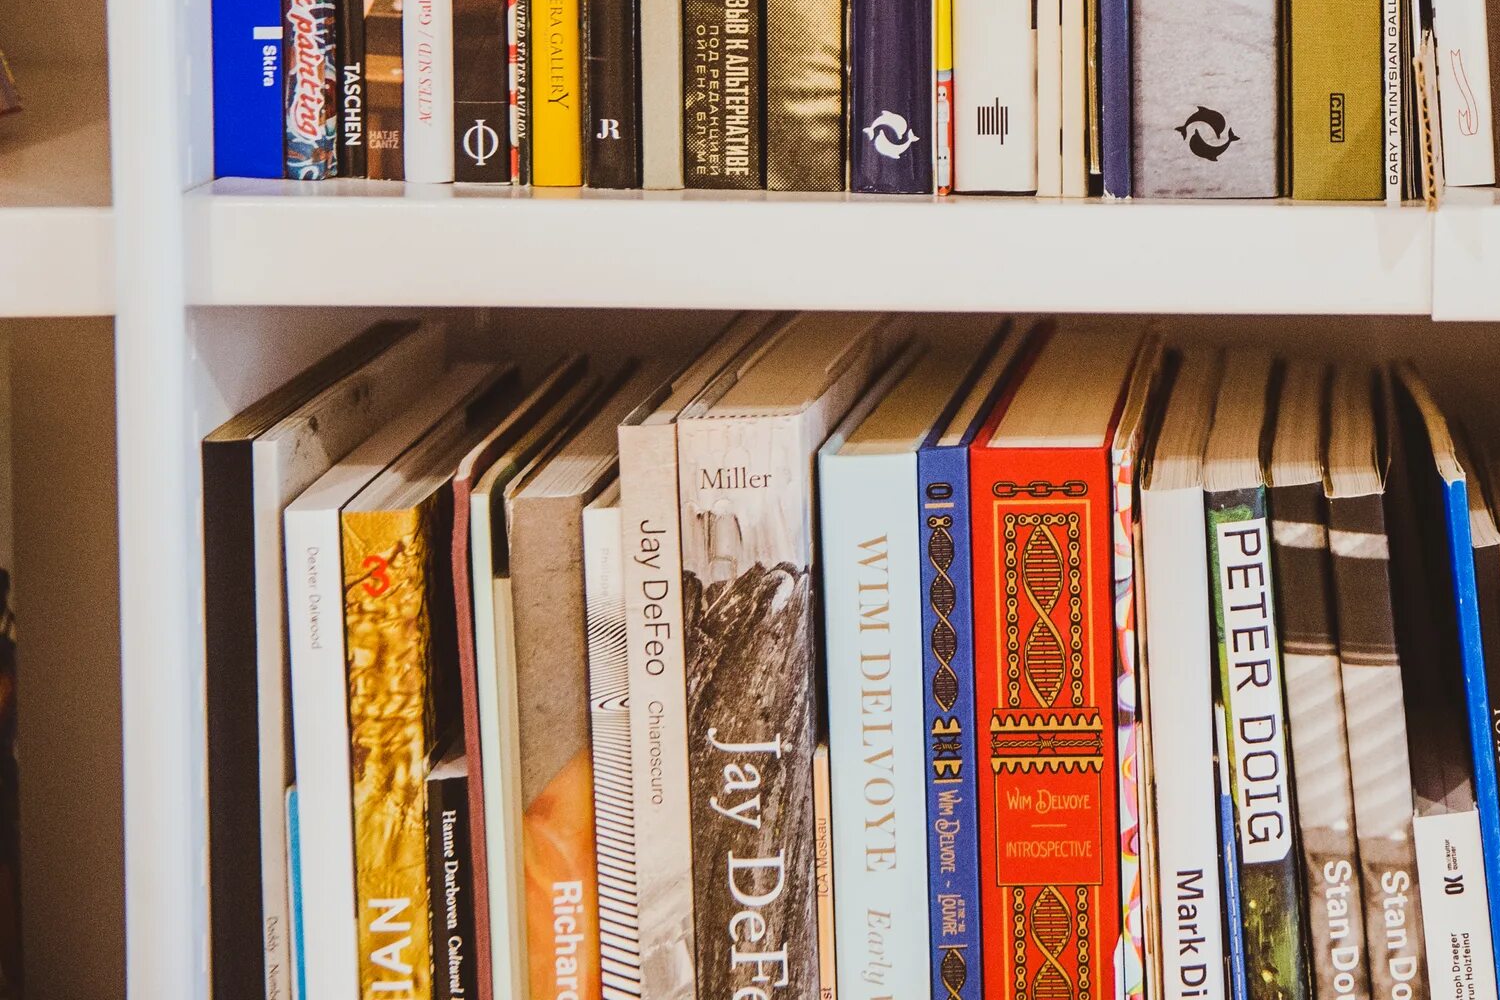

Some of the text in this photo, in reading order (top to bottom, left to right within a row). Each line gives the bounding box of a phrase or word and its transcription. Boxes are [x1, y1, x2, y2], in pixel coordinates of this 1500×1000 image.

[262, 45, 276, 86] Skira
[343, 62, 361, 146] TASCHEN
[547, 33, 570, 110] GALLERY
[725, 55, 750, 175] АЛЬТЕРНАТИВЕ
[699, 469, 772, 490] Miller
[634, 519, 670, 805] Jay DeFeo Chiaroscuro
[856, 534, 896, 873] WIM DELVOYE
[1224, 528, 1284, 847] PETER DOIG
[440, 810, 464, 993] Hanne Darboven Cultural
